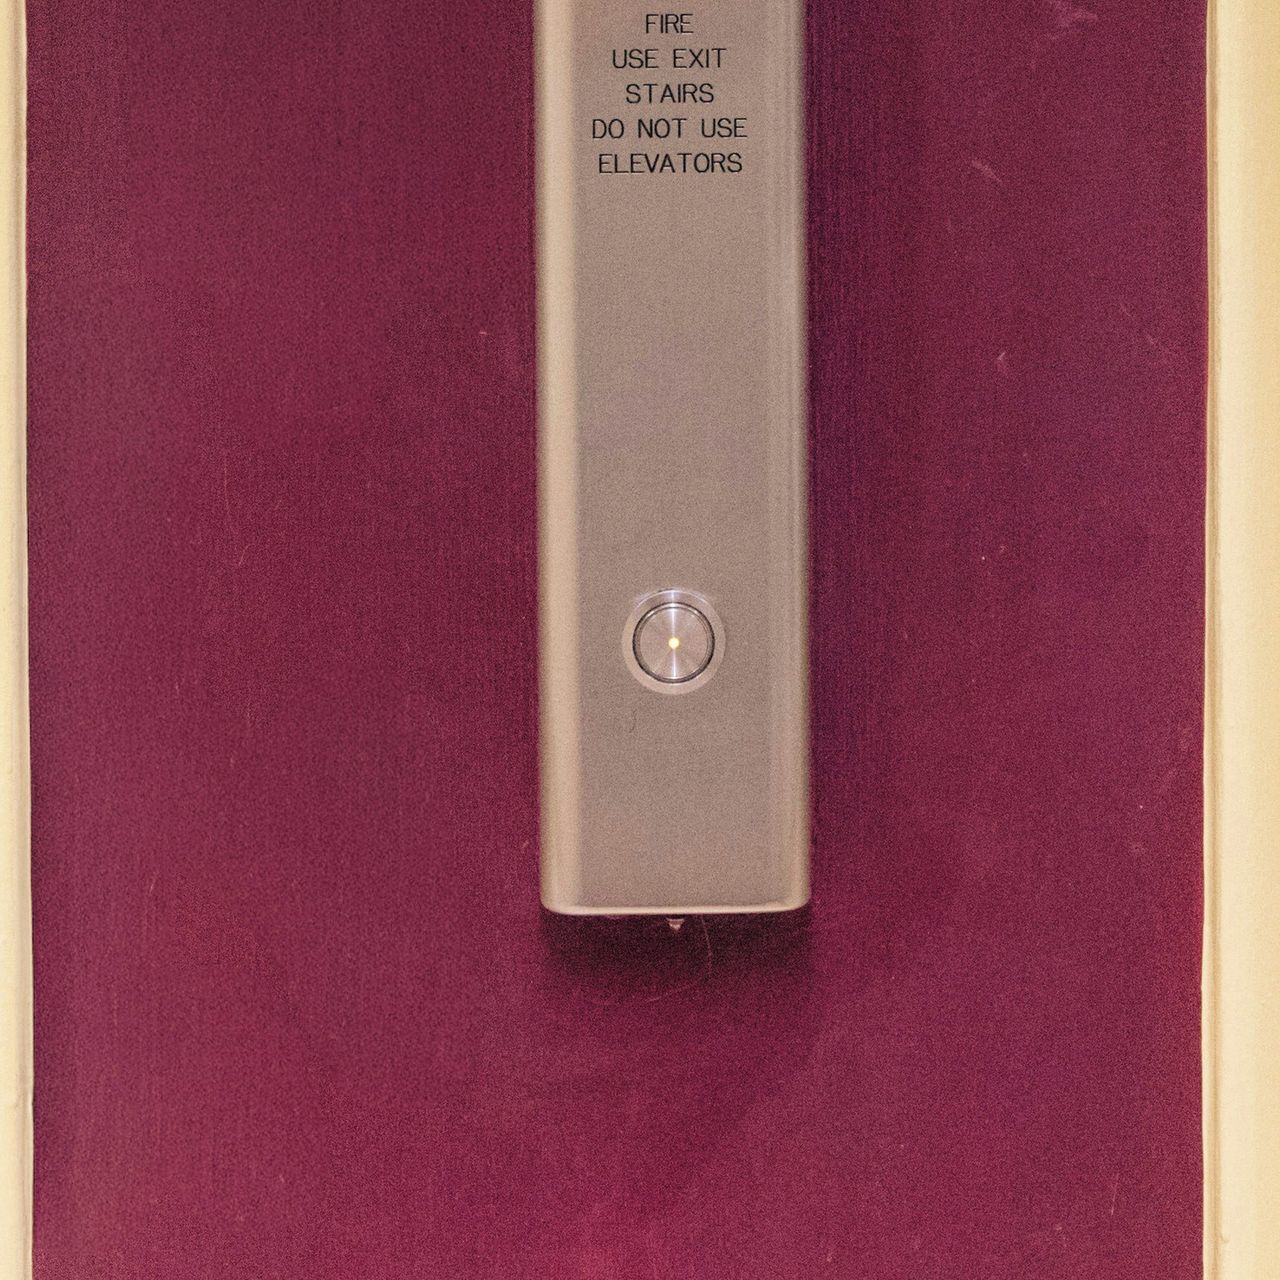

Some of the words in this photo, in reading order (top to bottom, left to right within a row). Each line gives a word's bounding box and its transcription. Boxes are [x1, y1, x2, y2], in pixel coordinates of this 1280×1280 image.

[645, 13, 694, 34] FIRE
[612, 48, 659, 69] USE
[672, 48, 727, 69] EXIT
[625, 82, 715, 104] STAIRS
[592, 118, 625, 139] DO
[637, 118, 687, 139] NOT
[701, 117, 748, 138] USE
[598, 152, 743, 174] ELEVATORS
